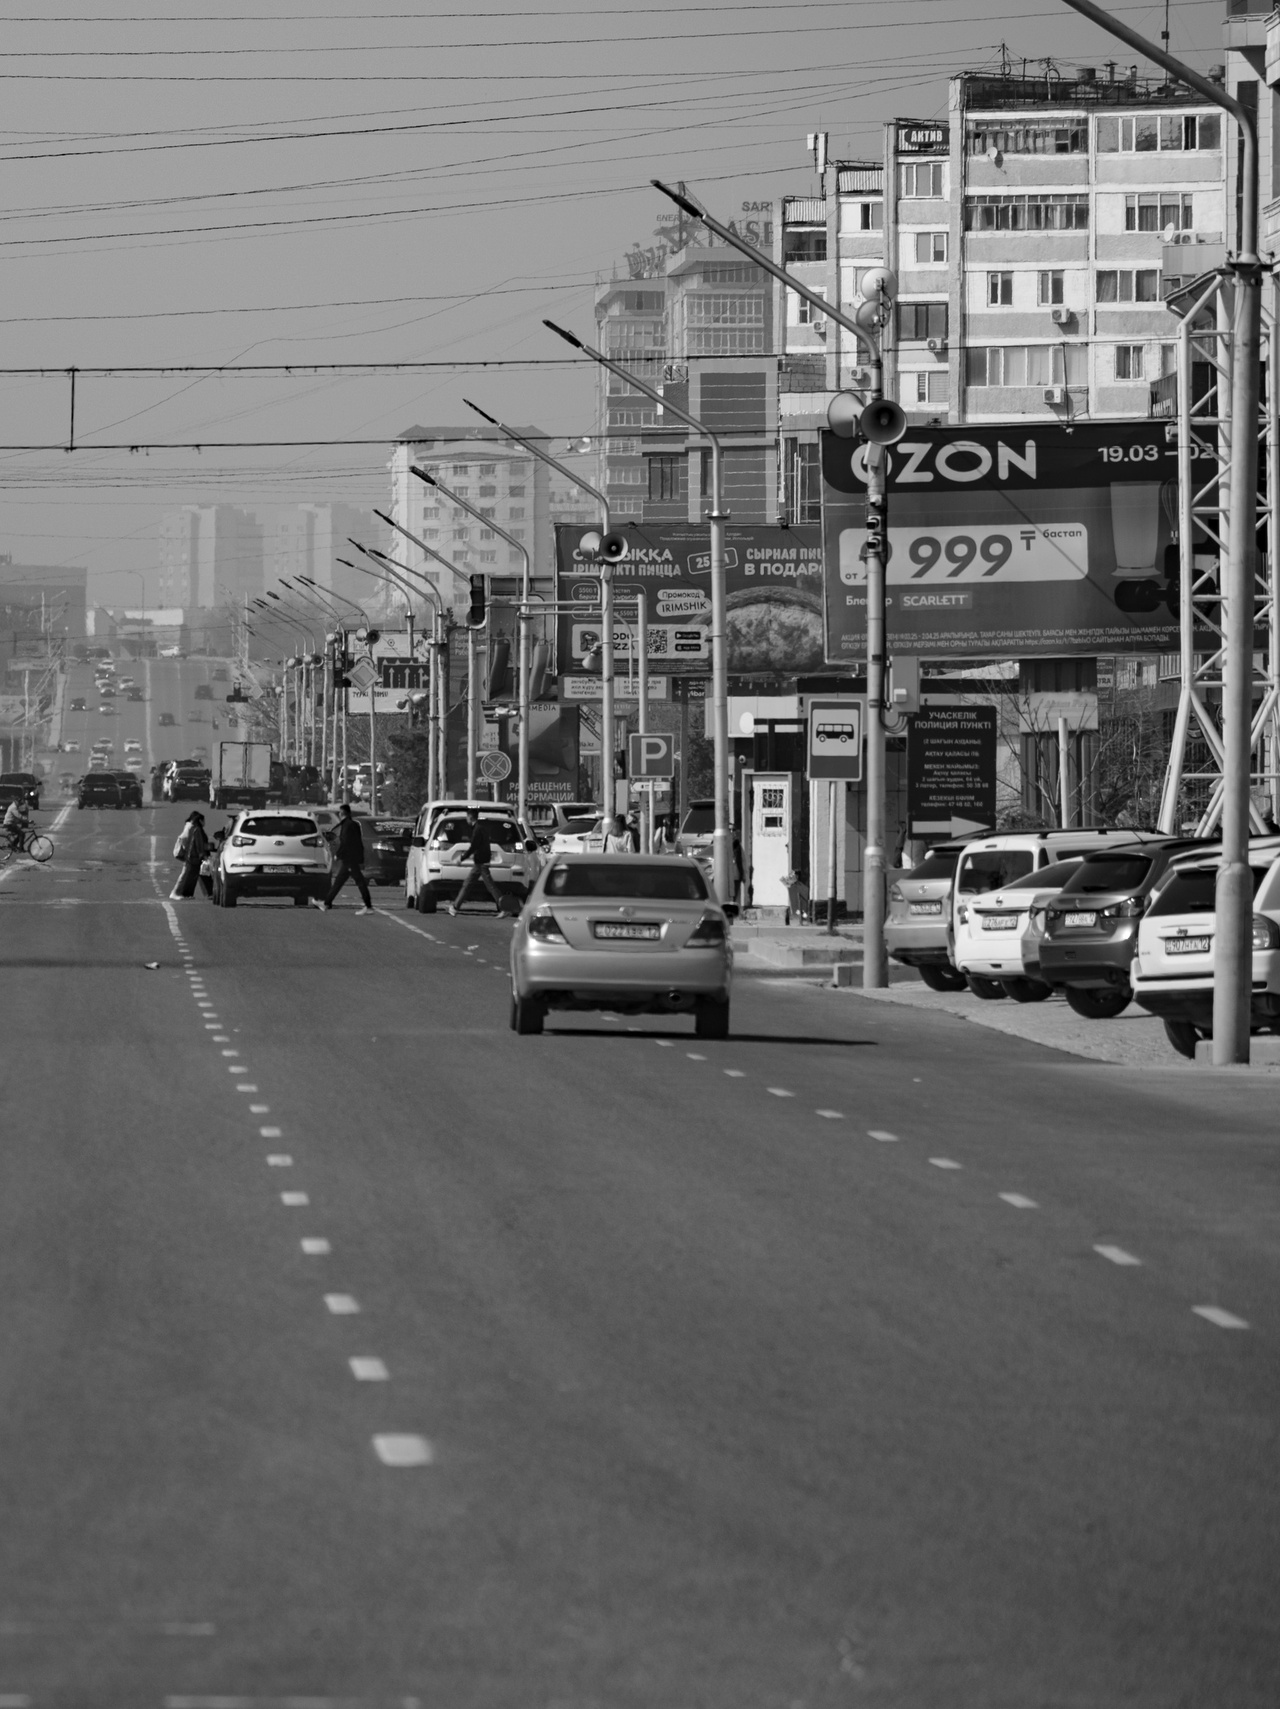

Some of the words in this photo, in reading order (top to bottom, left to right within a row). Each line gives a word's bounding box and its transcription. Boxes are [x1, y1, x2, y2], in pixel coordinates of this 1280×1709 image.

[910, 130, 944, 143] АКТИВ
[1098, 444, 1159, 463] 19.03
[1043, 529, 1083, 539] бастап
[746, 548, 797, 560] СЫРНАЯ
[638, 564, 682, 577] ПИЦЦА
[744, 563, 756, 576] В
[759, 562, 822, 578] ПОДАР
[662, 591, 700, 600] Промокод
[902, 594, 966, 608] SCARLETT
[662, 601, 707, 612] IRIMSHIK
[928, 711, 977, 720] УЧАСКЕЛІК
[914, 721, 958, 730] ПОЛИЦИЯ
[960, 721, 992, 729] ПУНКТІ
[640, 737, 668, 775] P
[509, 781, 572, 792] РАМЕЩЕНИЕ
[507, 792, 575, 803] ИНОРМАЦИИ
